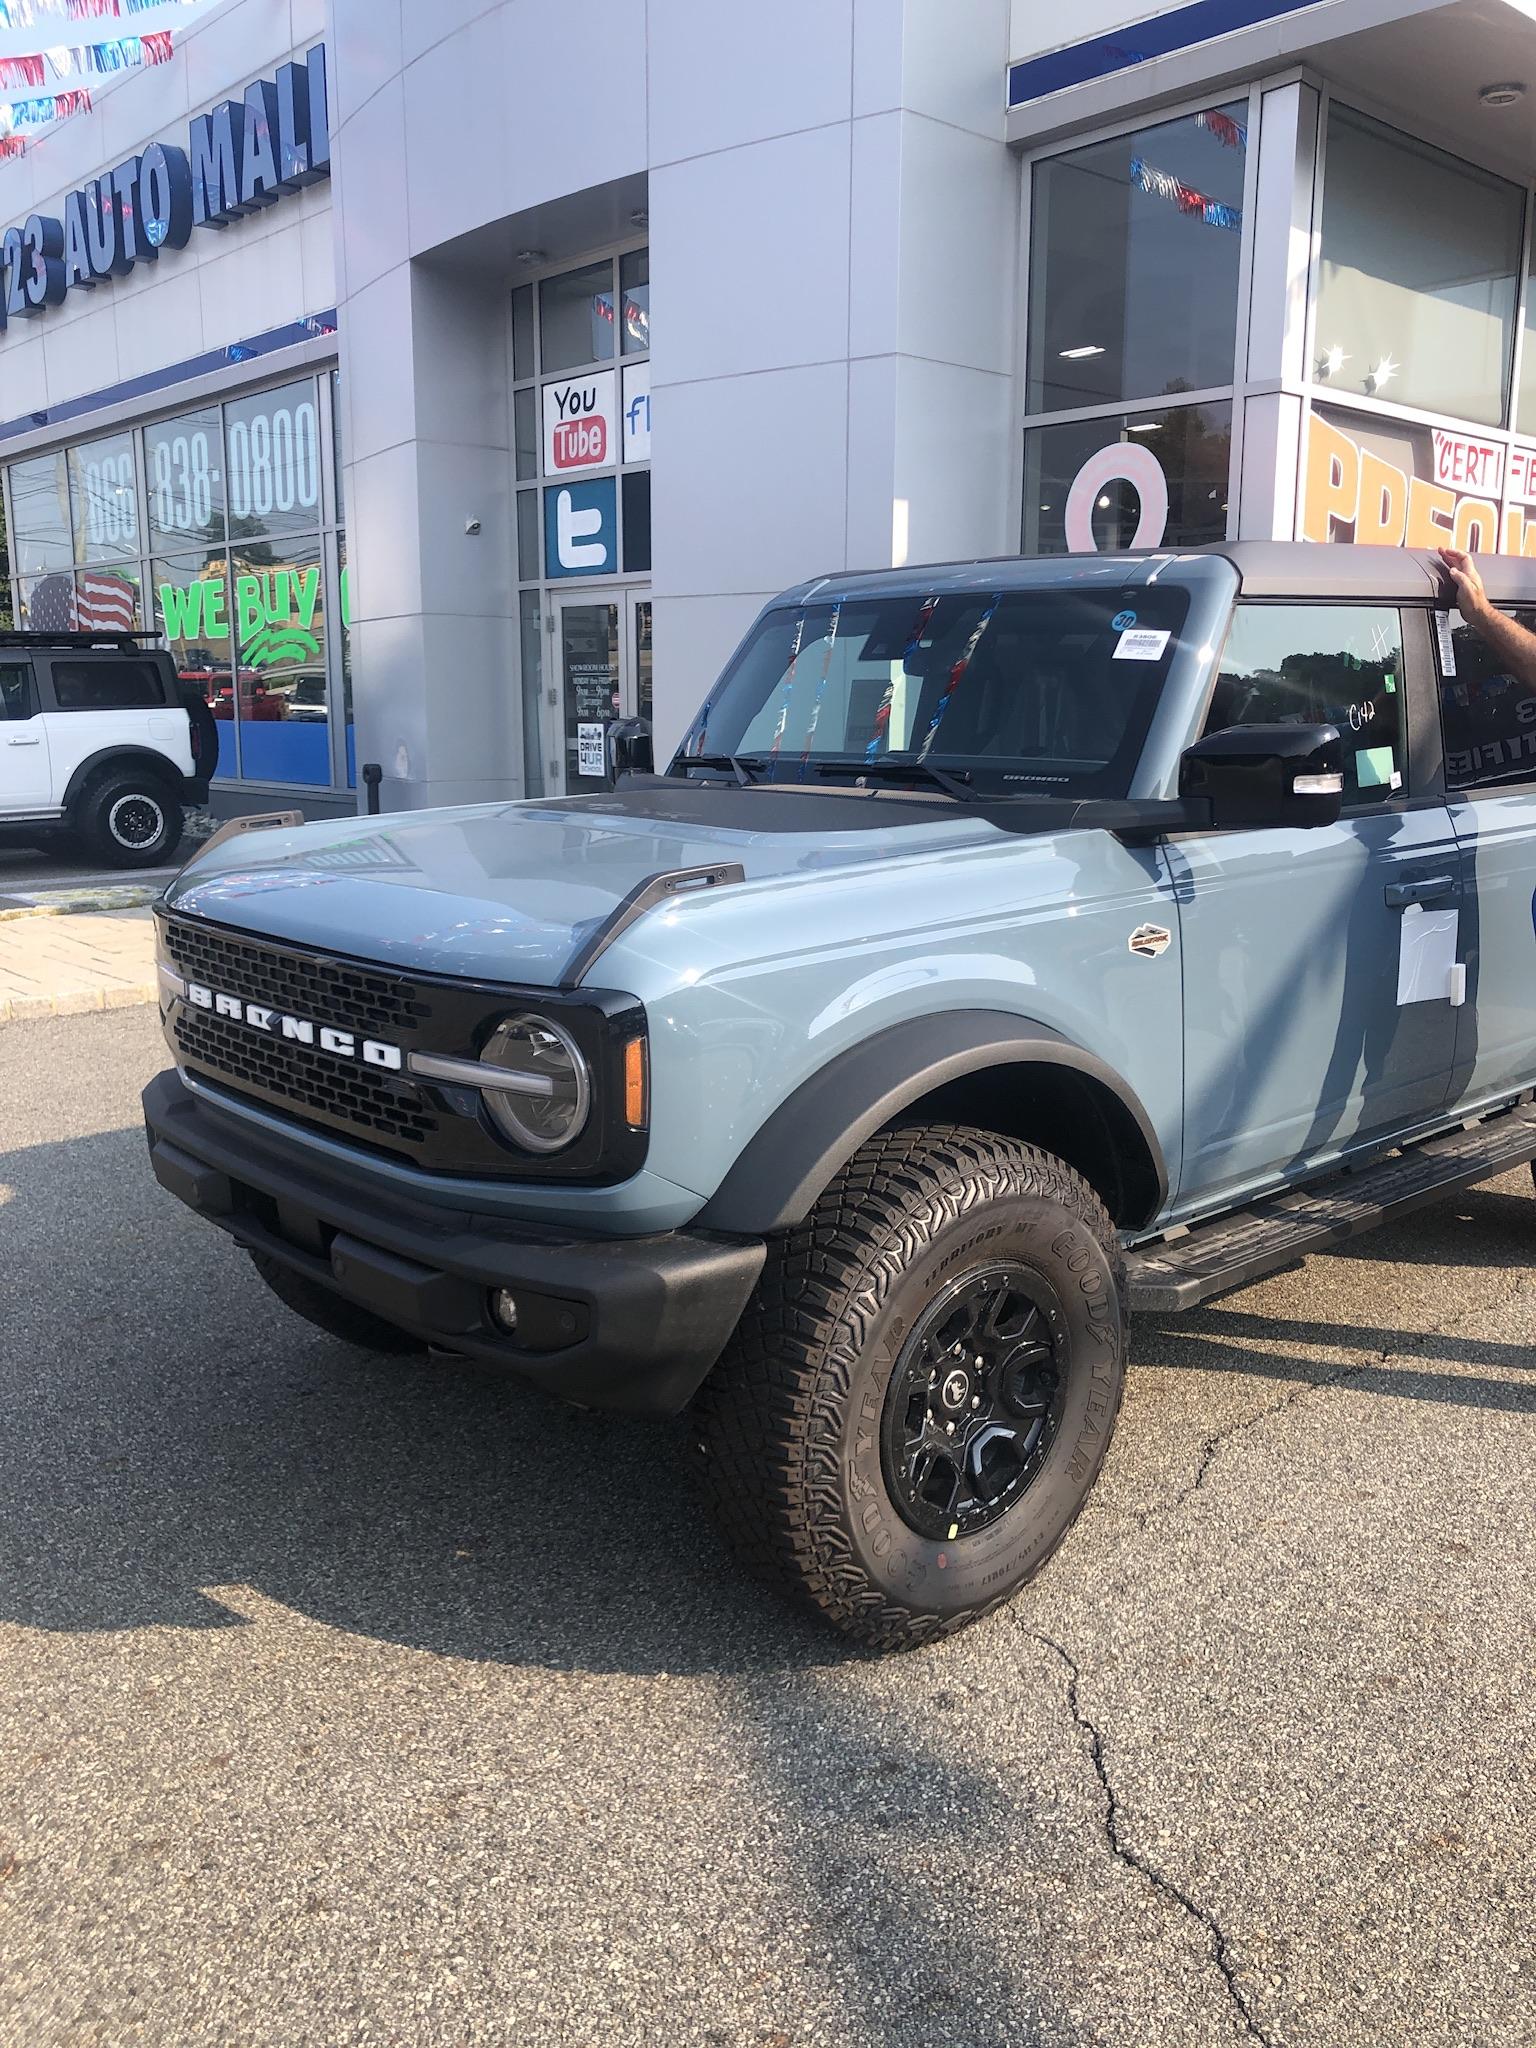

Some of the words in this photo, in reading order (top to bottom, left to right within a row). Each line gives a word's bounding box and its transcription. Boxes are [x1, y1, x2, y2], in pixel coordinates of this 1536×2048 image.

[65, 142, 184, 289] AUTO
[555, 424, 602, 461] Tube
[160, 579, 229, 641] WE
[237, 568, 320, 647] BUY
[580, 742, 602, 752] DRIVE
[580, 753, 602, 765] 4UR
[189, 983, 401, 1070] BRONCO
